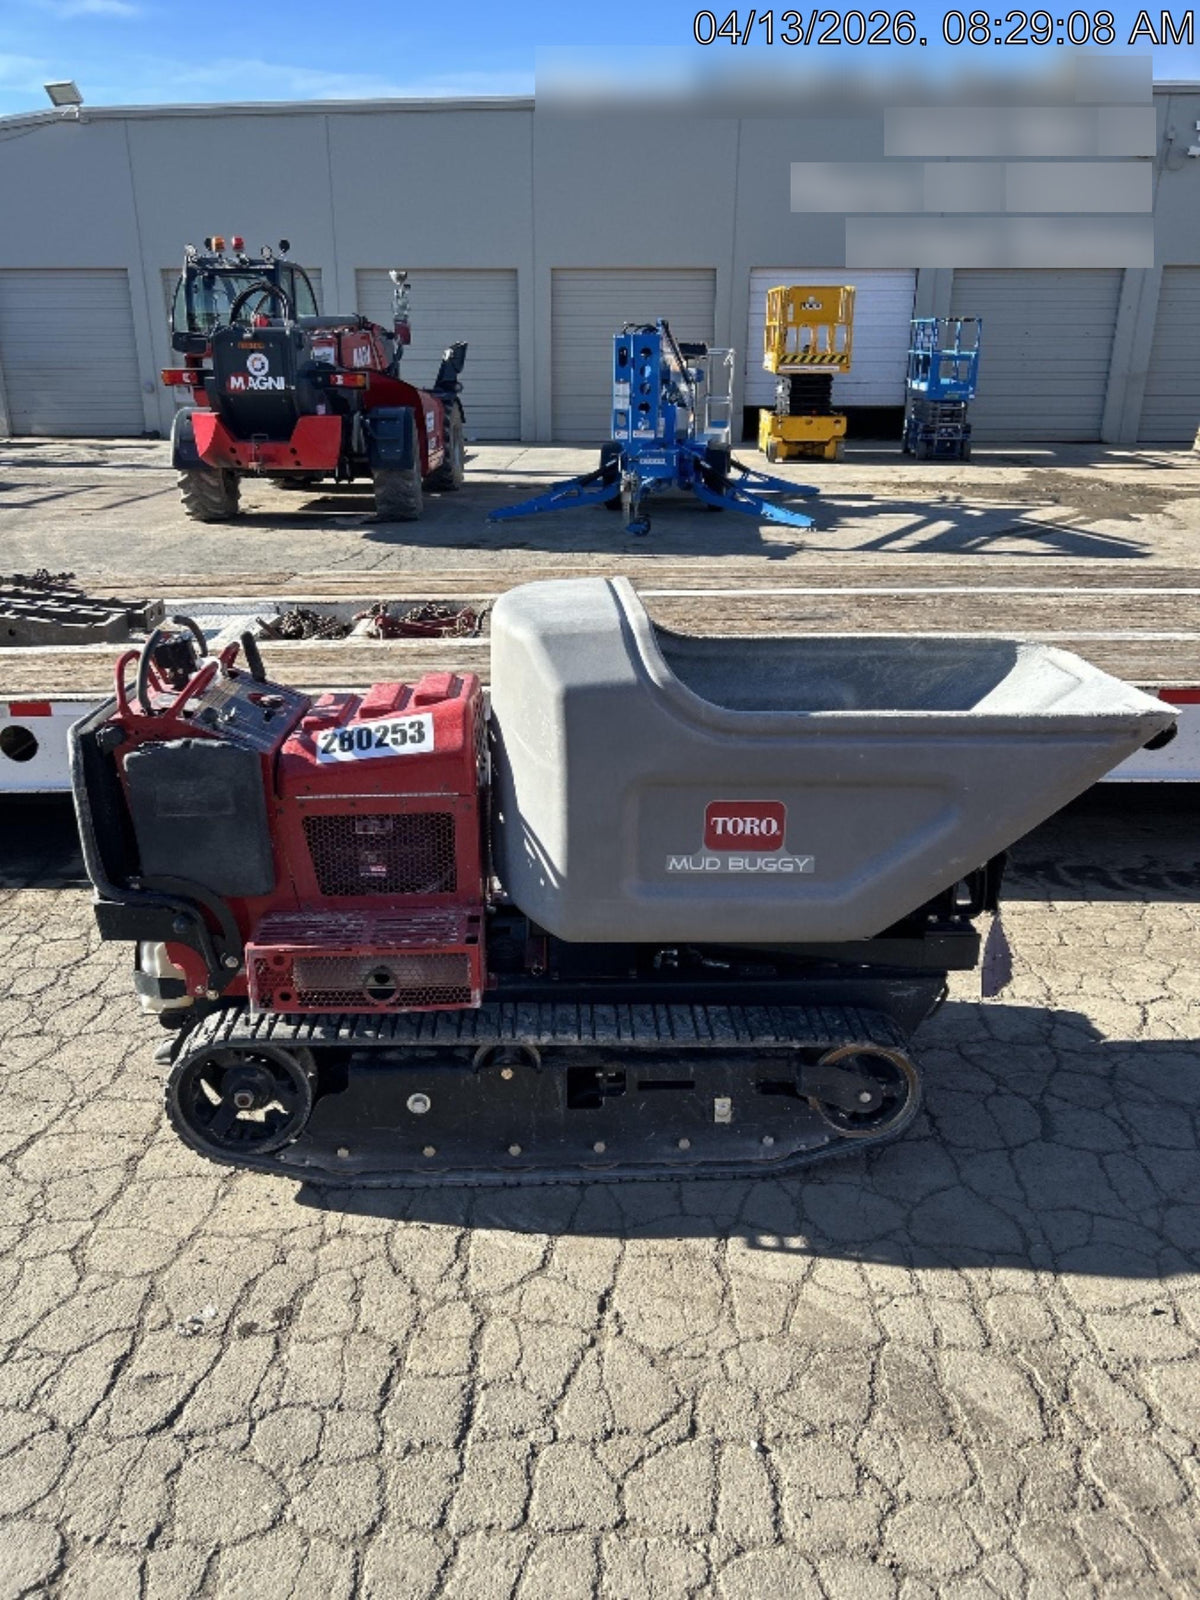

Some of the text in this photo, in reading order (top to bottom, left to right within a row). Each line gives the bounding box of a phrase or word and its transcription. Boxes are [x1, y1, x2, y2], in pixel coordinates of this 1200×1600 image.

[230, 376, 285, 390] MAGNI
[321, 720, 426, 755] 280253
[711, 817, 778, 836] TORO
[668, 857, 810, 872] MUD BUGGY
